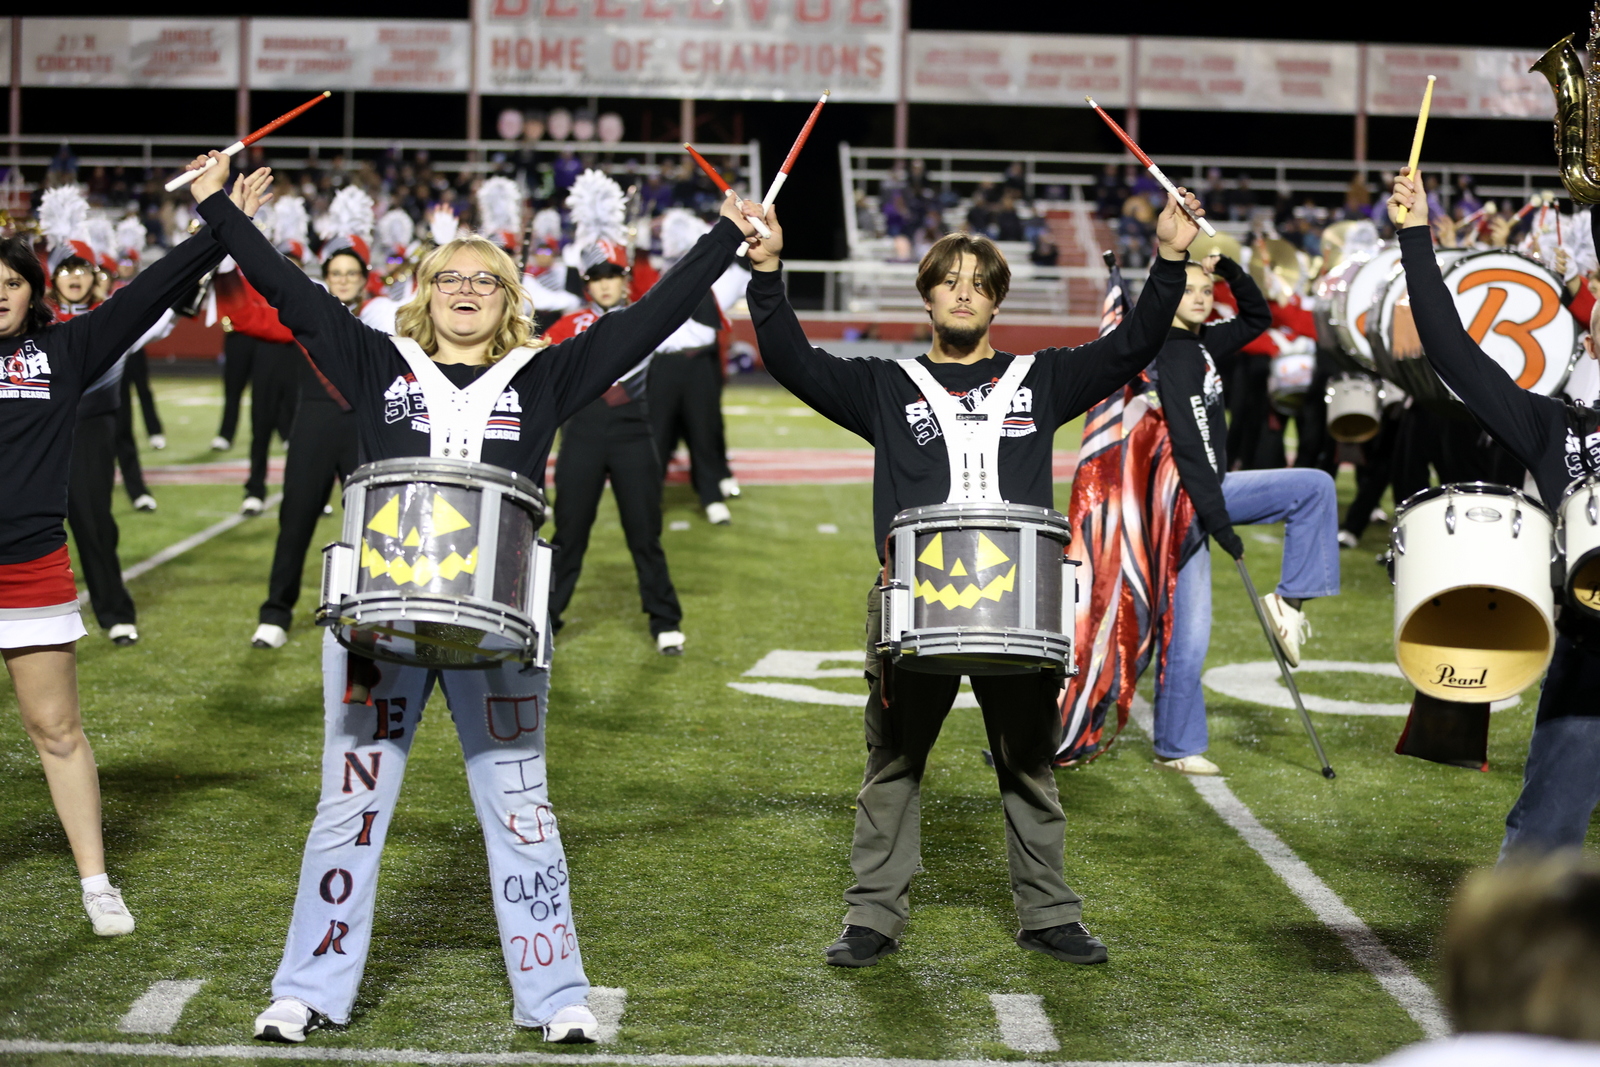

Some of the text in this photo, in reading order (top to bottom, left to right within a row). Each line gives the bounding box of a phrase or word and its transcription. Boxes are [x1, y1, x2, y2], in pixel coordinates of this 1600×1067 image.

[490, 38, 885, 79] HOME OF CHAMPIONS
[1457, 268, 1560, 390] B
[1429, 663, 1488, 688] Pearl
[312, 662, 407, 956] ENIOR
[503, 859, 568, 904] CLASS
[530, 893, 563, 922] OF
